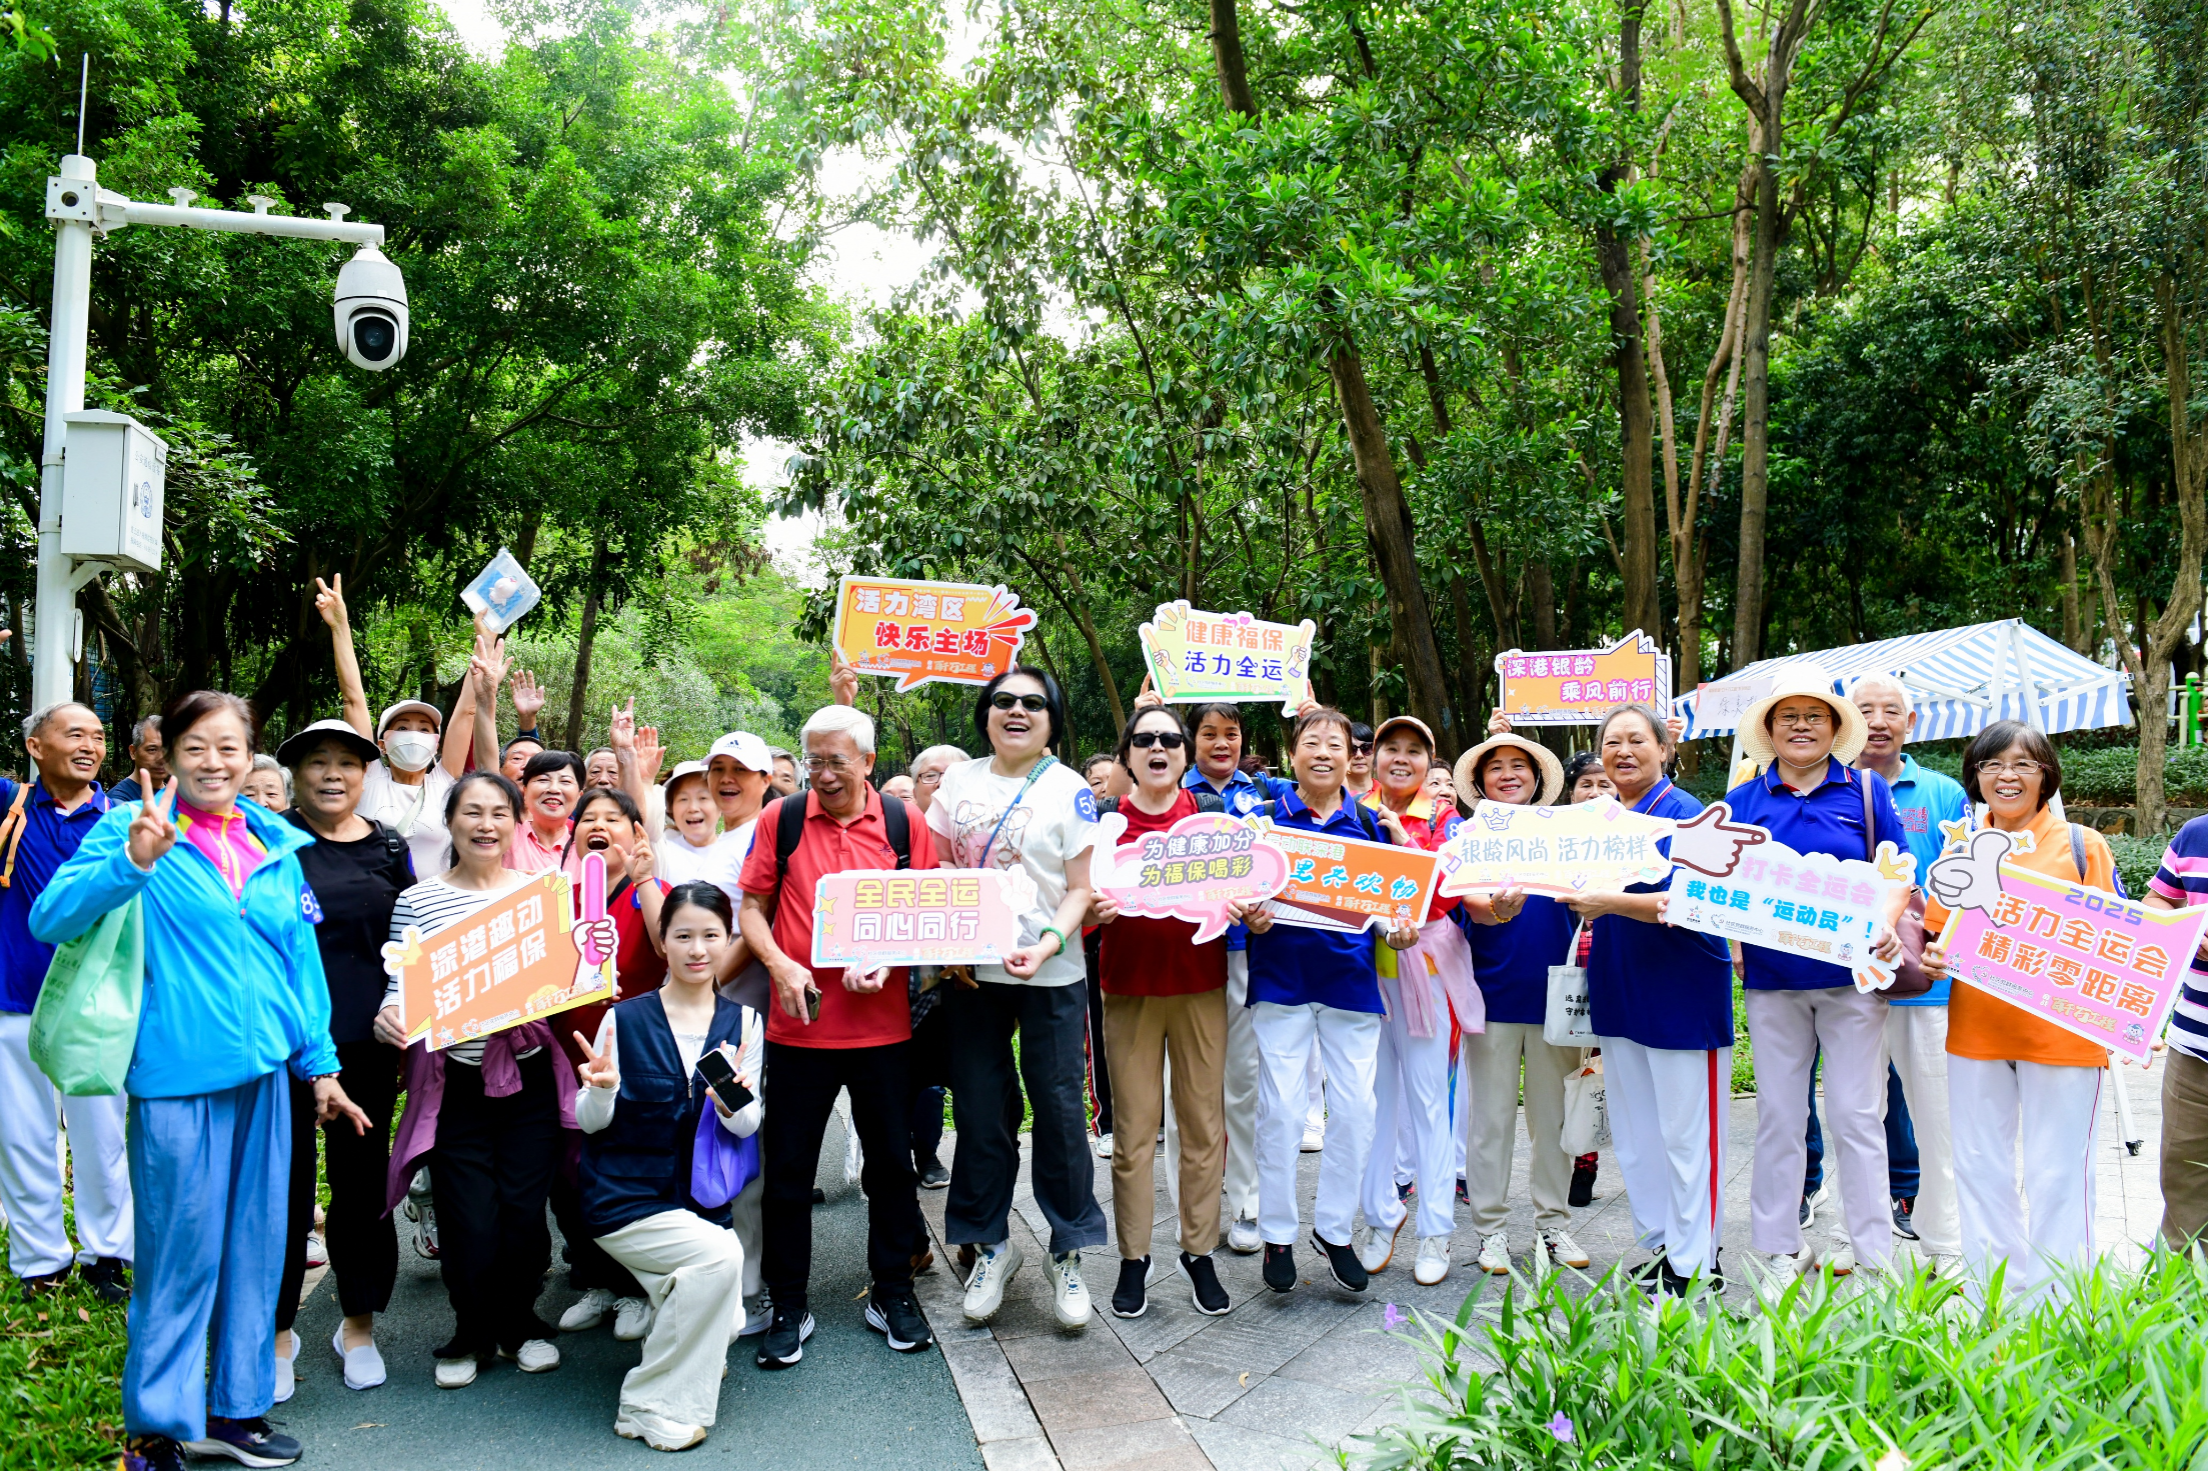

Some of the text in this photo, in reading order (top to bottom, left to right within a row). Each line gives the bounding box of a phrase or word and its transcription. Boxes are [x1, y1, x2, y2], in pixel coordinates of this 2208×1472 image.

[855, 587, 966, 622] 活力湾区
[875, 621, 991, 658] 快乐主场
[1185, 619, 1283, 652] 健康福保
[1184, 650, 1283, 681] 活力全运
[1506, 655, 1595, 678] 深港银龄
[1560, 679, 1653, 702] 乘风前行
[1142, 828, 1256, 861] 为健康加分
[1461, 834, 1649, 864] 银龄风尚 活力榜样
[1139, 855, 1254, 887] 为福保喝彩
[1742, 856, 1877, 907] 打卡全运会
[854, 878, 980, 909] 全民全运
[2064, 887, 2144, 926] 2025
[430, 894, 544, 984] 深港趣动
[852, 911, 979, 942] 同心同行
[1993, 893, 2171, 979] 活力全运会
[433, 928, 547, 1021] 活力福保
[1978, 930, 2156, 1018] 精彩零距离
